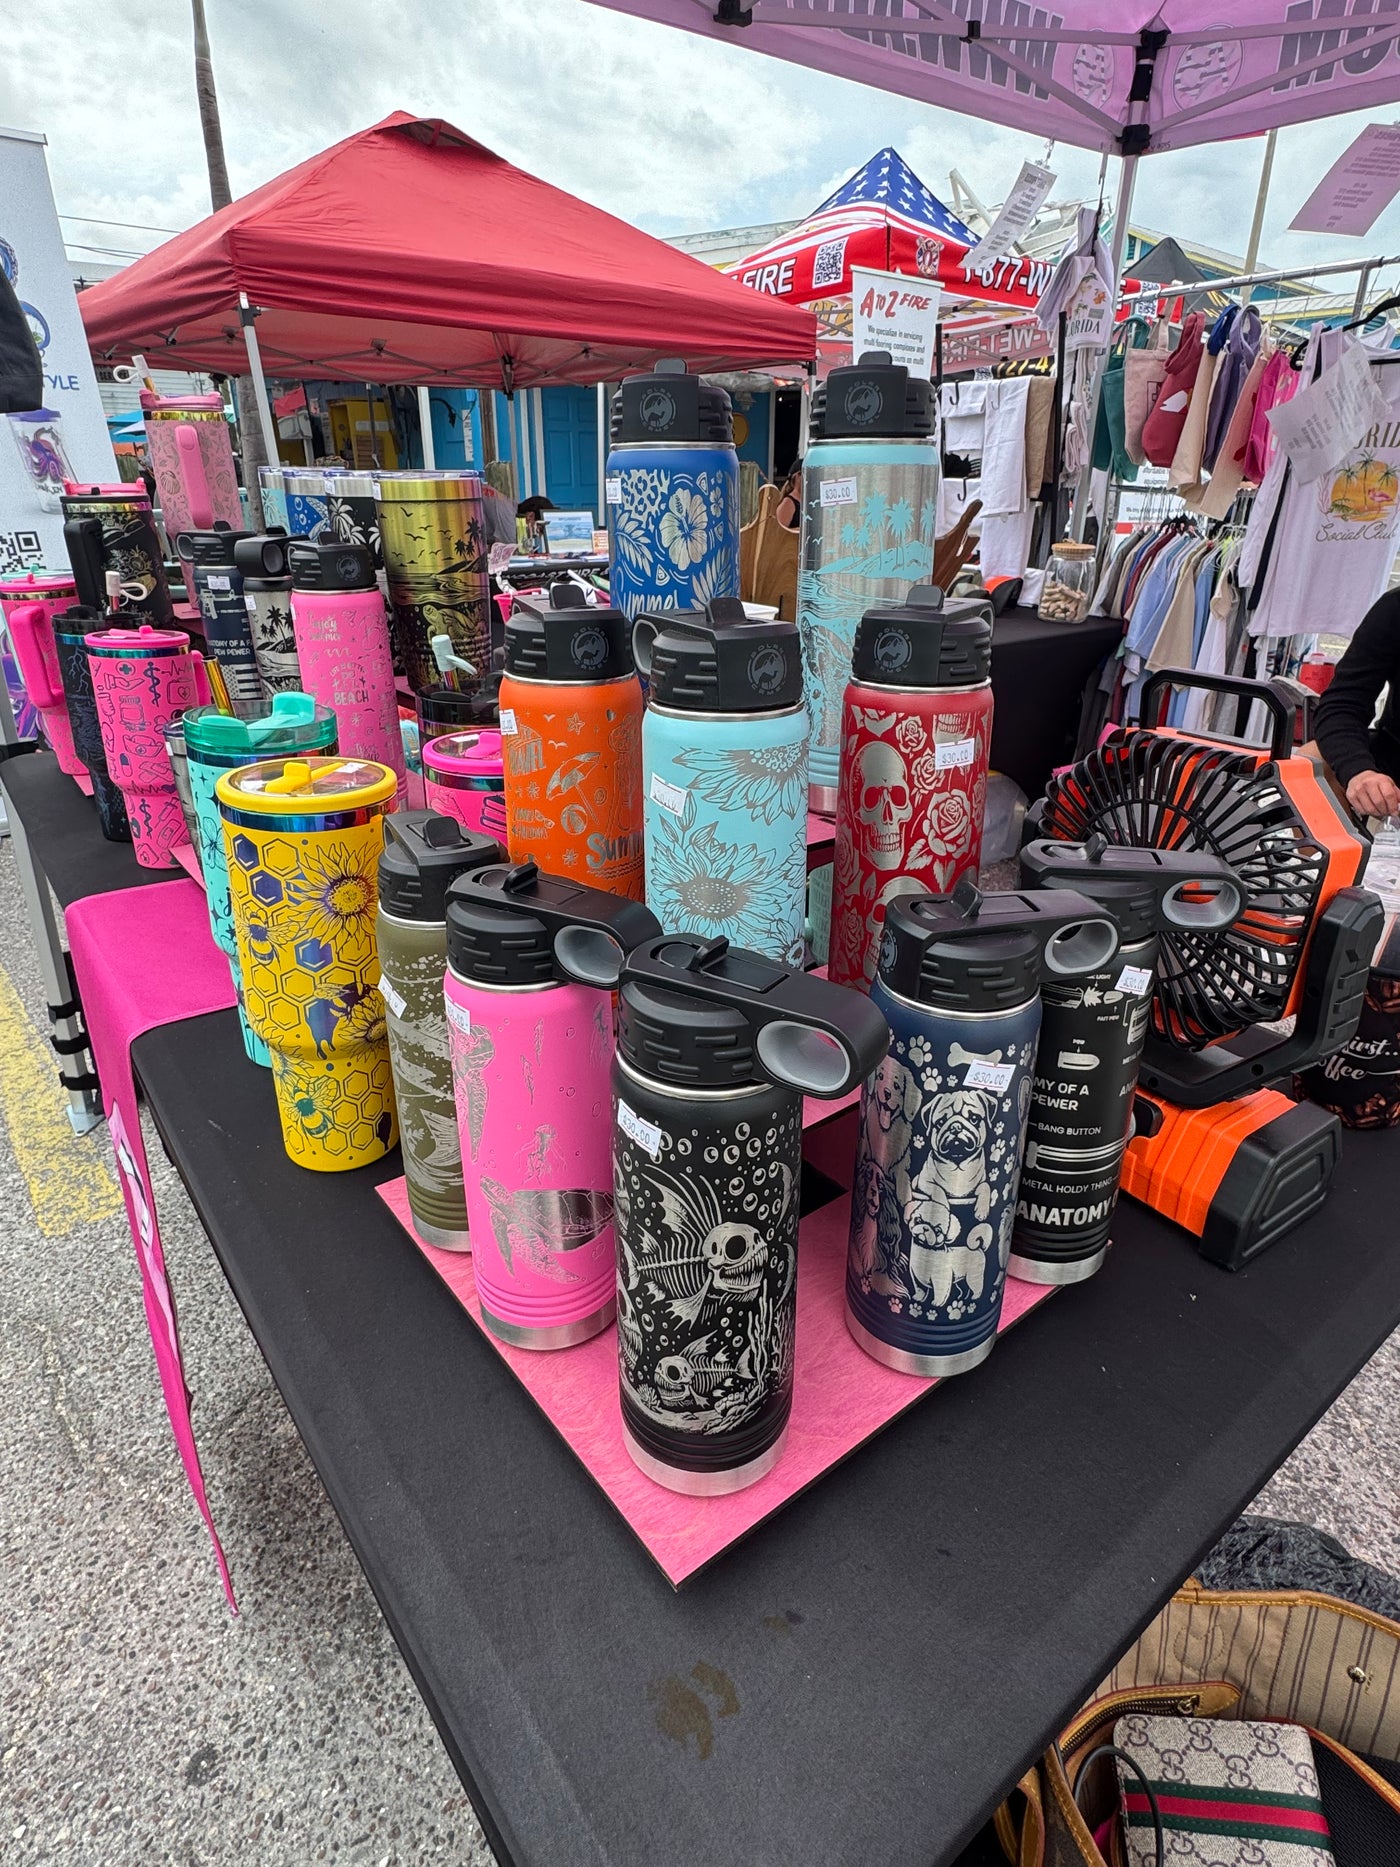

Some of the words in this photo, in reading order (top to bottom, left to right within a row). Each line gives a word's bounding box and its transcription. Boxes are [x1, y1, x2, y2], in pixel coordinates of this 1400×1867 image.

[860, 287, 876, 319] A
[875, 298, 887, 310] TO
[885, 291, 899, 318] Z
[899, 293, 932, 310] FIRE
[825, 486, 851, 500] $30.00
[1315, 523, 1363, 543] Social
[1362, 520, 1396, 541] Club
[333, 689, 370, 705] BEACH
[942, 749, 969, 764] $30.00
[973, 1071, 1005, 1086] $30.00
[1057, 1083, 1078, 1096] OF
[1079, 1085, 1090, 1096] A
[622, 1113, 651, 1145] $30.00
[1038, 1122, 1065, 1135] BANG
[1066, 1126, 1102, 1136] BUTTON
[1022, 1177, 1054, 1192] METAL
[1056, 1184, 1089, 1194] HOLDY
[1091, 1176, 1113, 1190] THING
[1015, 1196, 1112, 1226] ANATOMY
